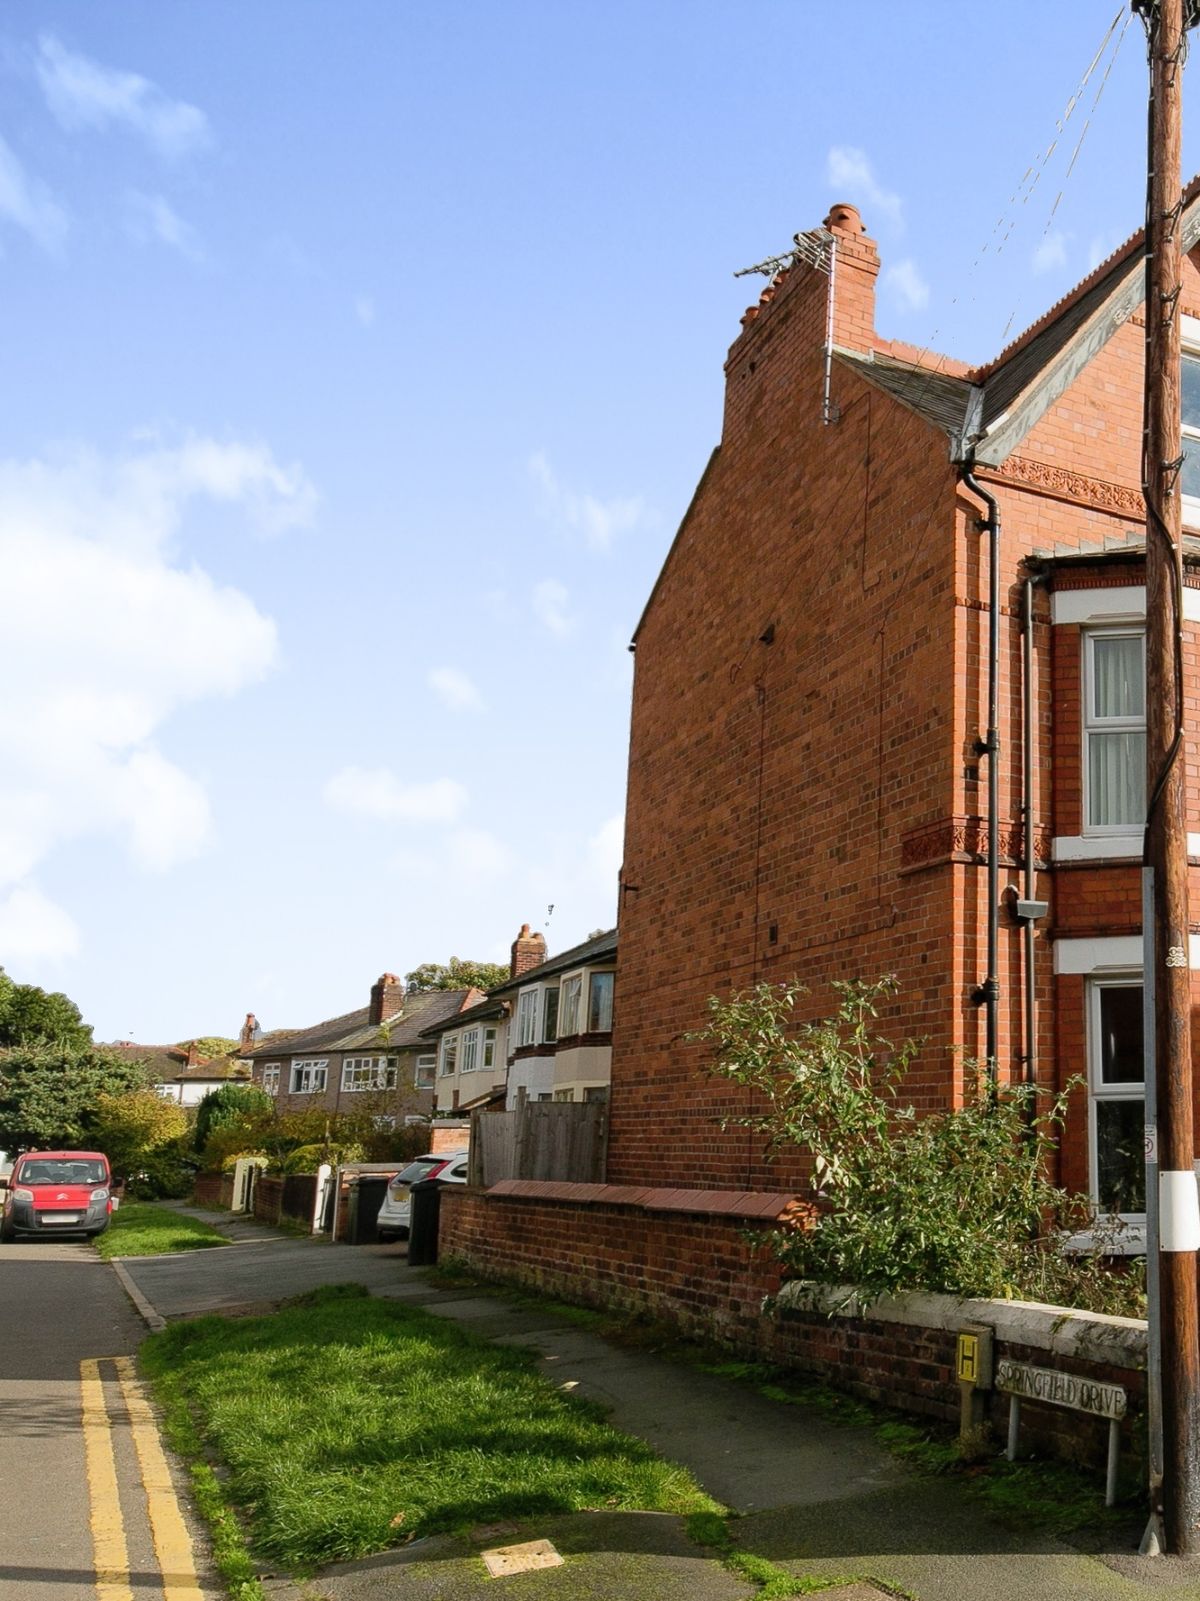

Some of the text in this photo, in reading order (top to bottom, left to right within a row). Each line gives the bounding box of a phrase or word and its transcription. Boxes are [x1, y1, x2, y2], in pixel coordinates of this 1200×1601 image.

[961, 1339, 975, 1378] H
[999, 1364, 1123, 1416] SPRINGFIELD DRIVE
